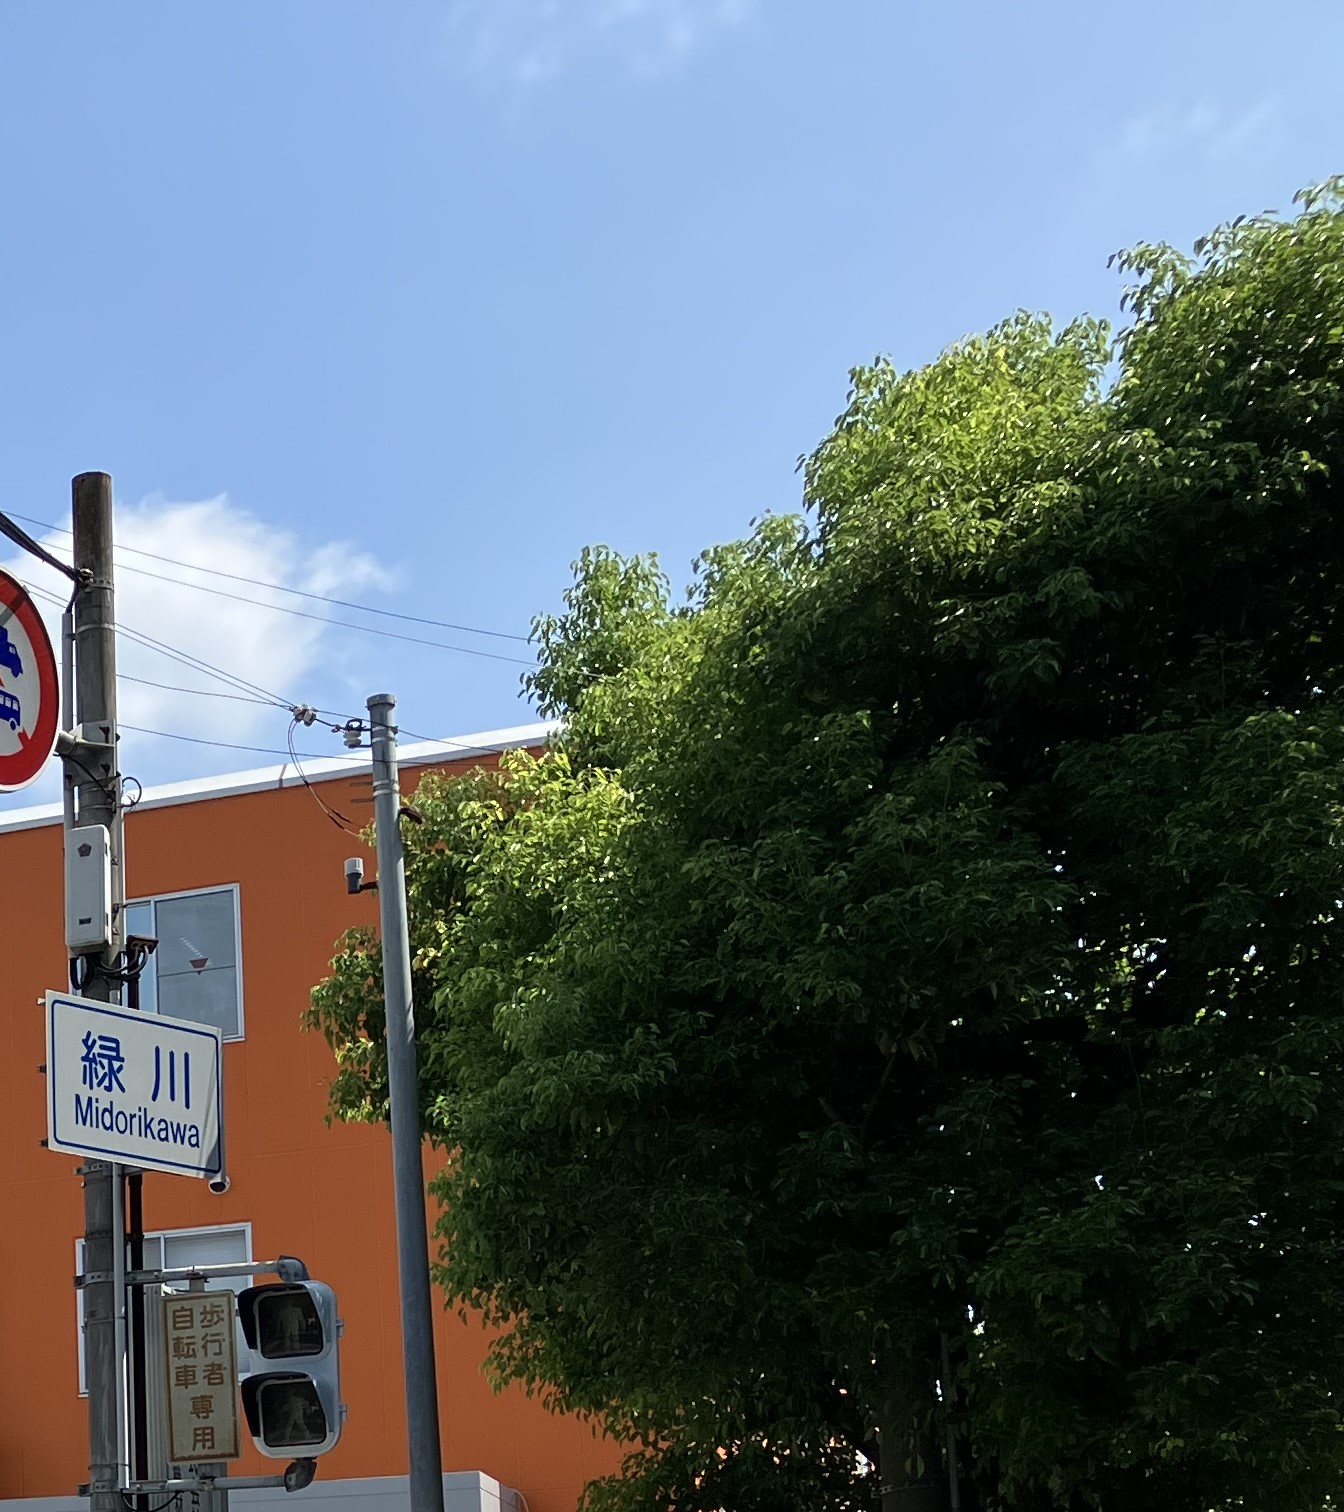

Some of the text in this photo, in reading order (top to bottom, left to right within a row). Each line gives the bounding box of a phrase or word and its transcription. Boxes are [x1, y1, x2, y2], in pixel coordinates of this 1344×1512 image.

[81, 1030, 190, 1110] 緑川
[74, 1093, 201, 1149] Midorikawa
[172, 1306, 198, 1389] 自転車
[199, 1303, 226, 1386] 歩行者
[190, 1394, 214, 1451] 専用
